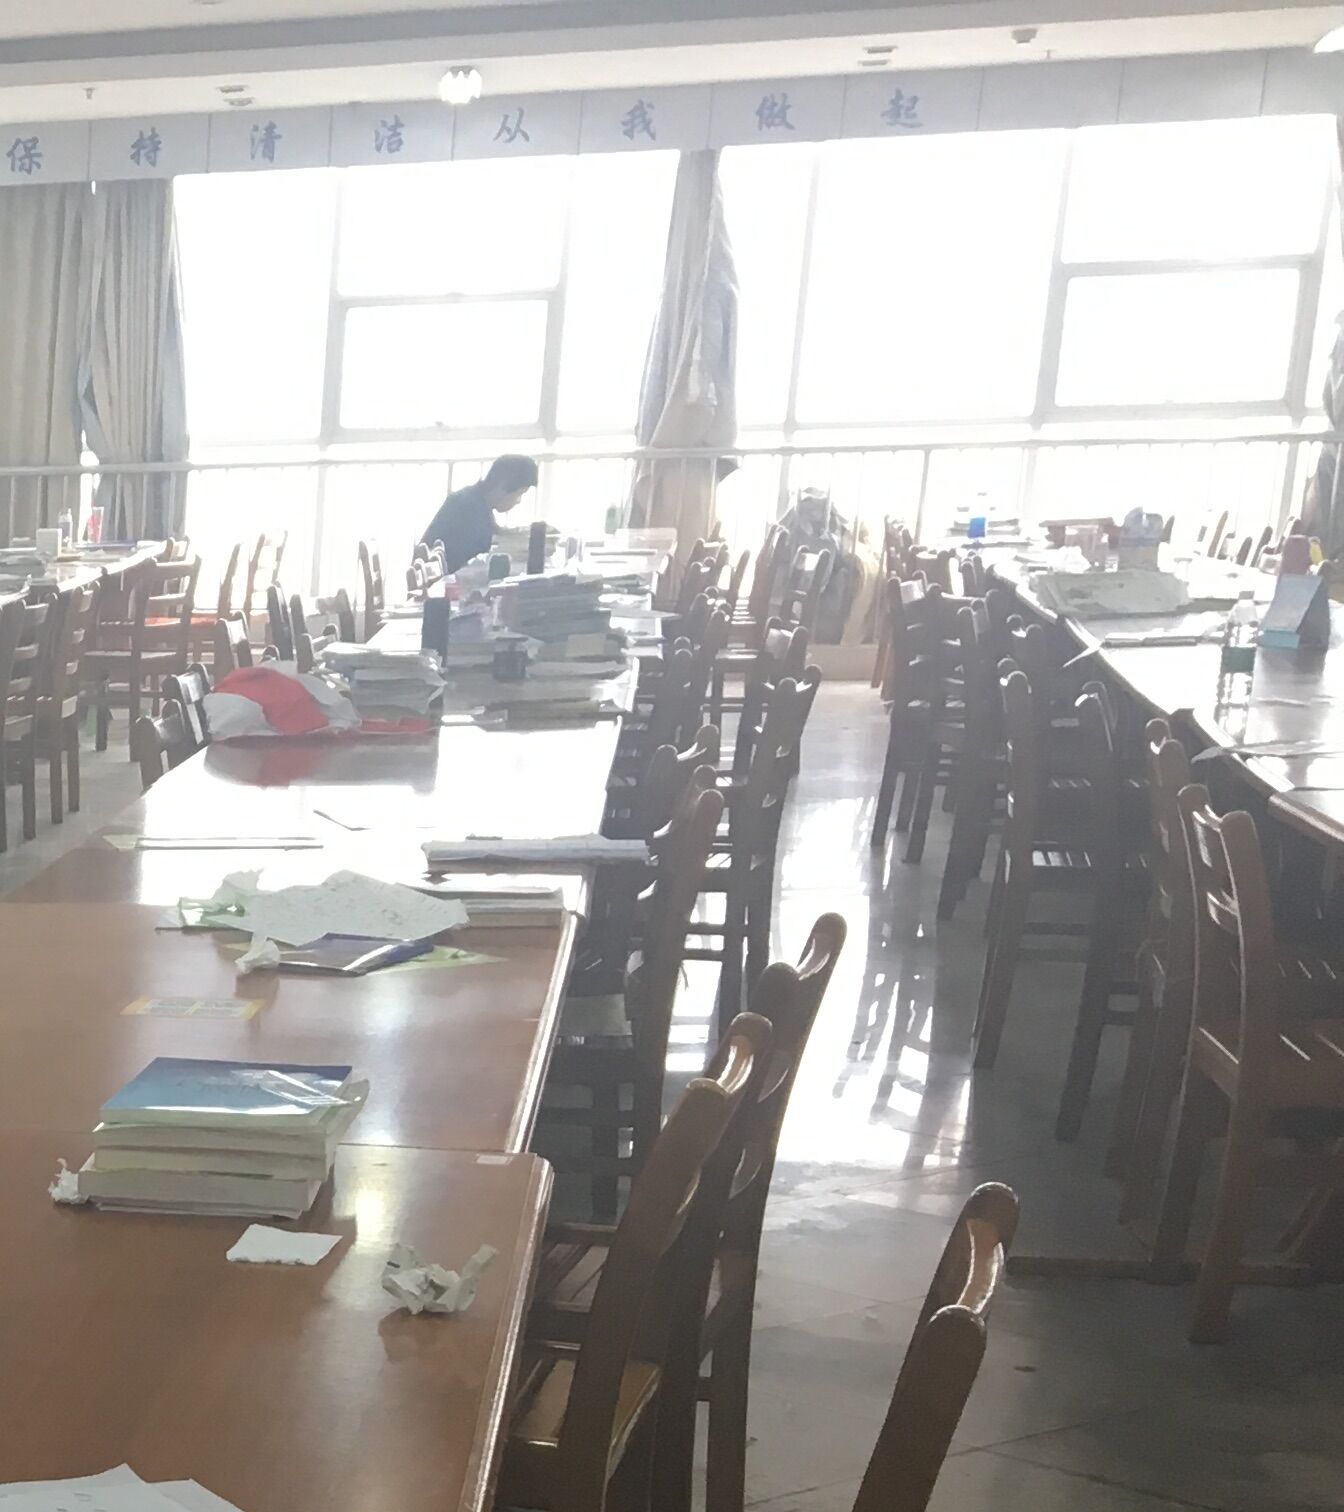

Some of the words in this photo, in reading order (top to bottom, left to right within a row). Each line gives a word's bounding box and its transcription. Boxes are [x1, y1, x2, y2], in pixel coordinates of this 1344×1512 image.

[6, 87, 923, 175] 保持清洁从我做起
